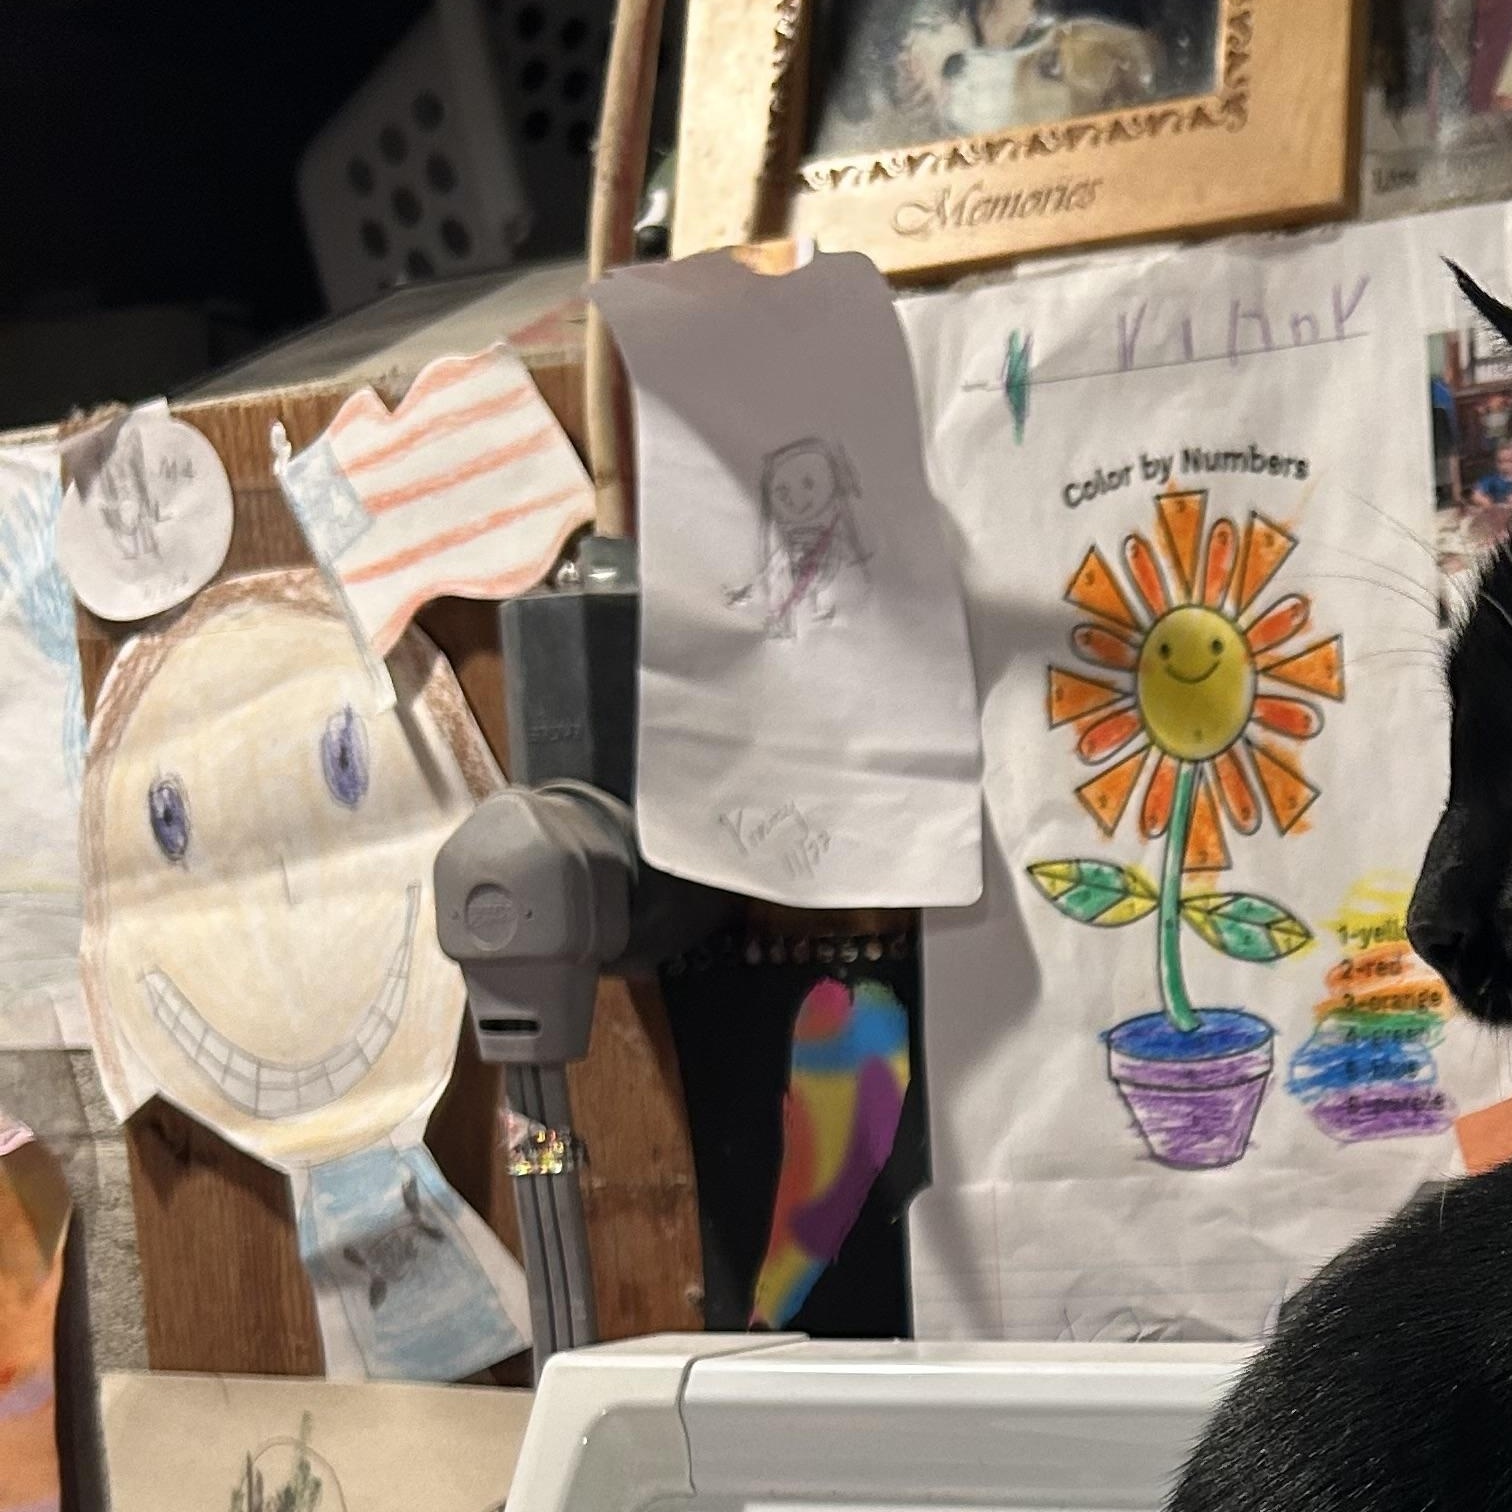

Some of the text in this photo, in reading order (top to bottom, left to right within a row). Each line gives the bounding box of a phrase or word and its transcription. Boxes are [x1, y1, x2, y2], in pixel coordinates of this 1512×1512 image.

[891, 178, 1103, 236] Memories
[1062, 465, 1134, 508] Color
[1140, 452, 1174, 485] by
[1180, 444, 1310, 481] Numbers
